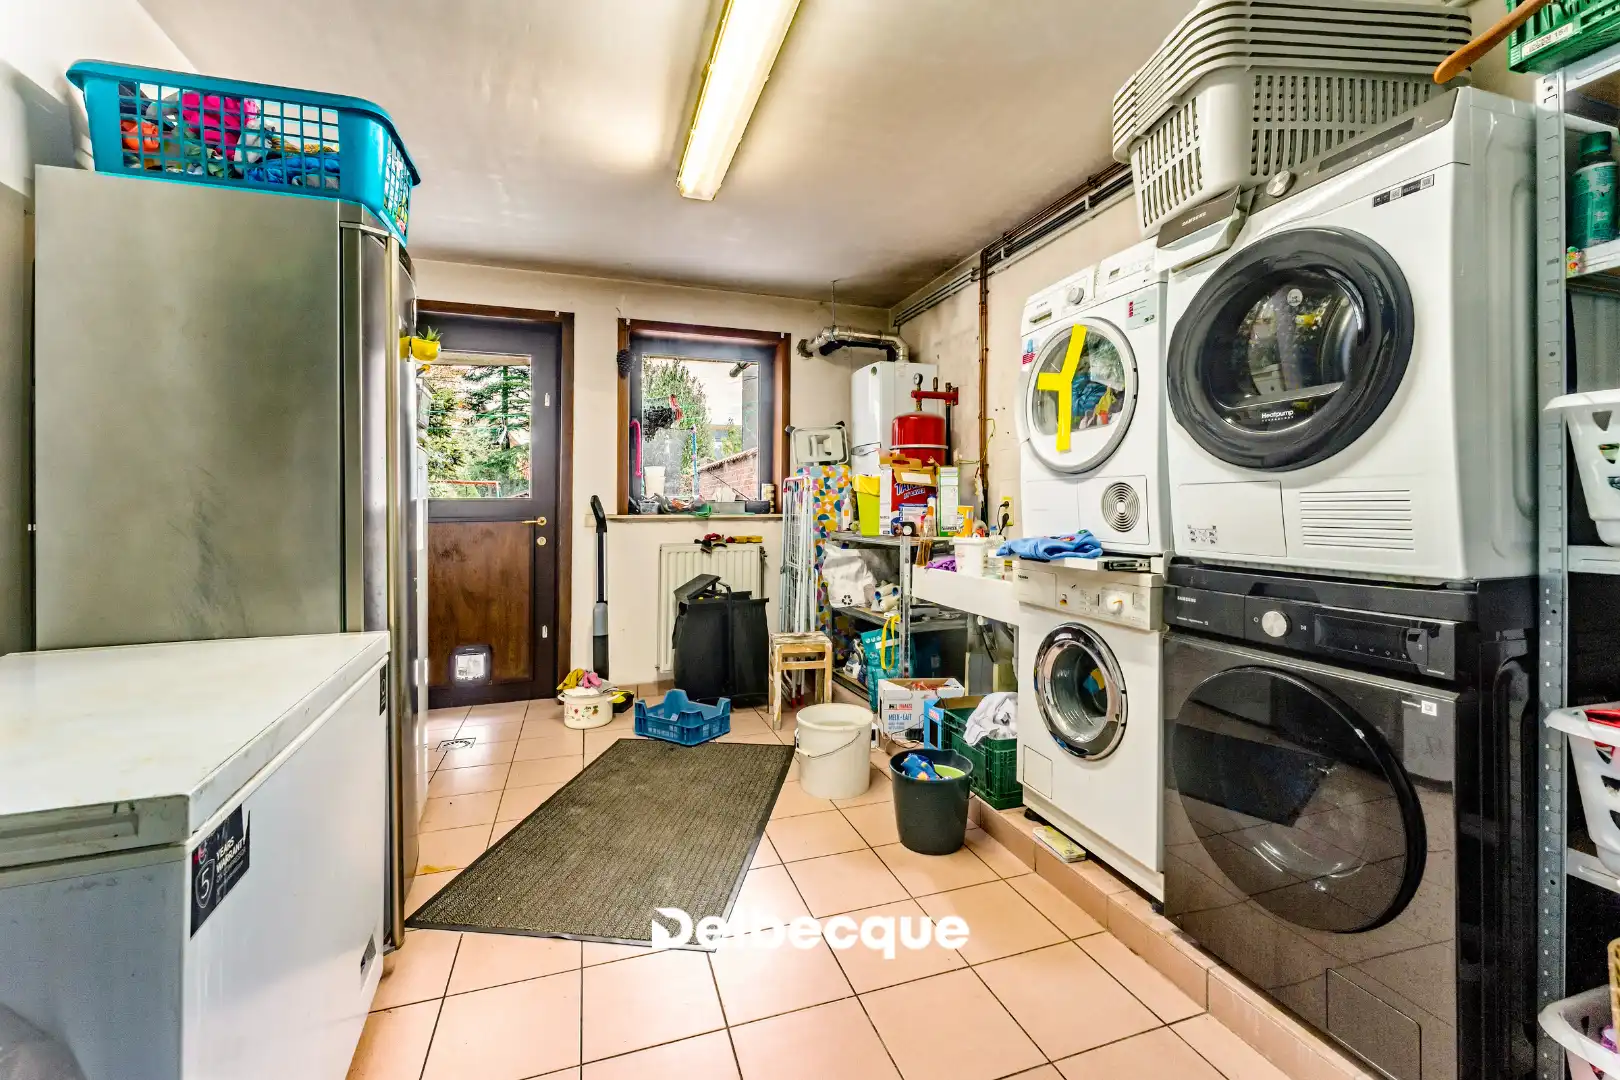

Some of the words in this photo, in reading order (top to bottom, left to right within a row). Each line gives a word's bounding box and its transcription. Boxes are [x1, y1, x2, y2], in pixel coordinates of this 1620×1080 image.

[1261, 410, 1294, 419] Heatpump
[216, 837, 246, 873] WARRANTY
[201, 867, 210, 900] 5
